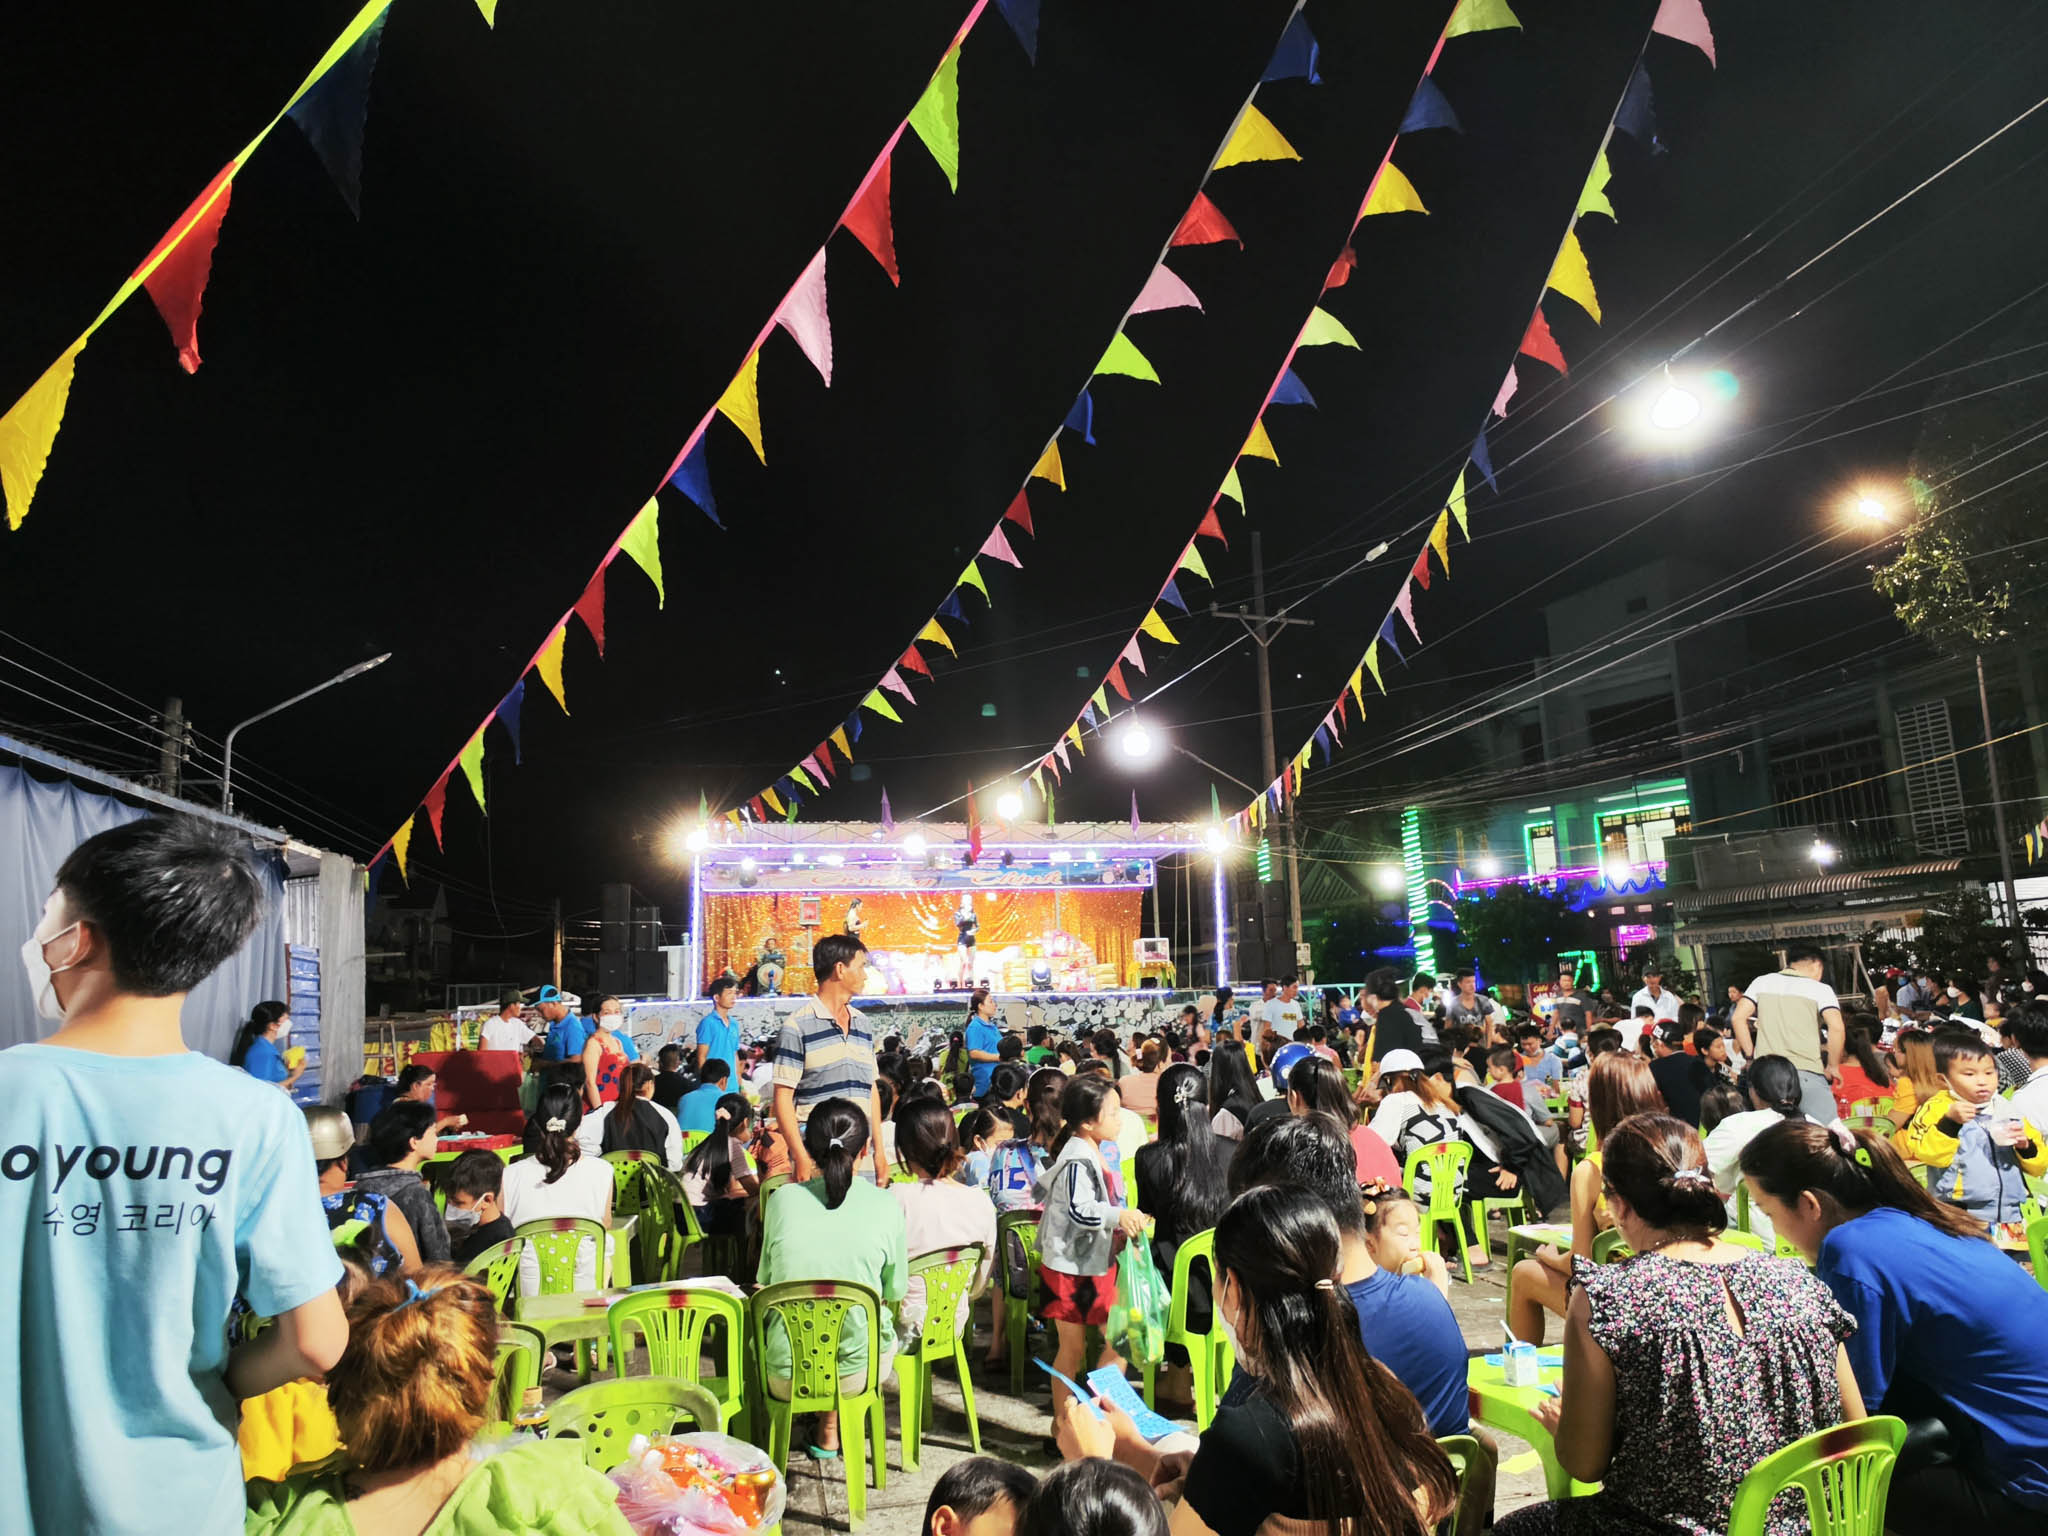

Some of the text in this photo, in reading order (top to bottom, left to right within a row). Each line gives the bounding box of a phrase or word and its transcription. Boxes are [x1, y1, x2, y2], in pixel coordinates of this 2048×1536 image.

[1, 1144, 232, 1195] oyoung
[42, 1202, 216, 1236] 수영 코리아
